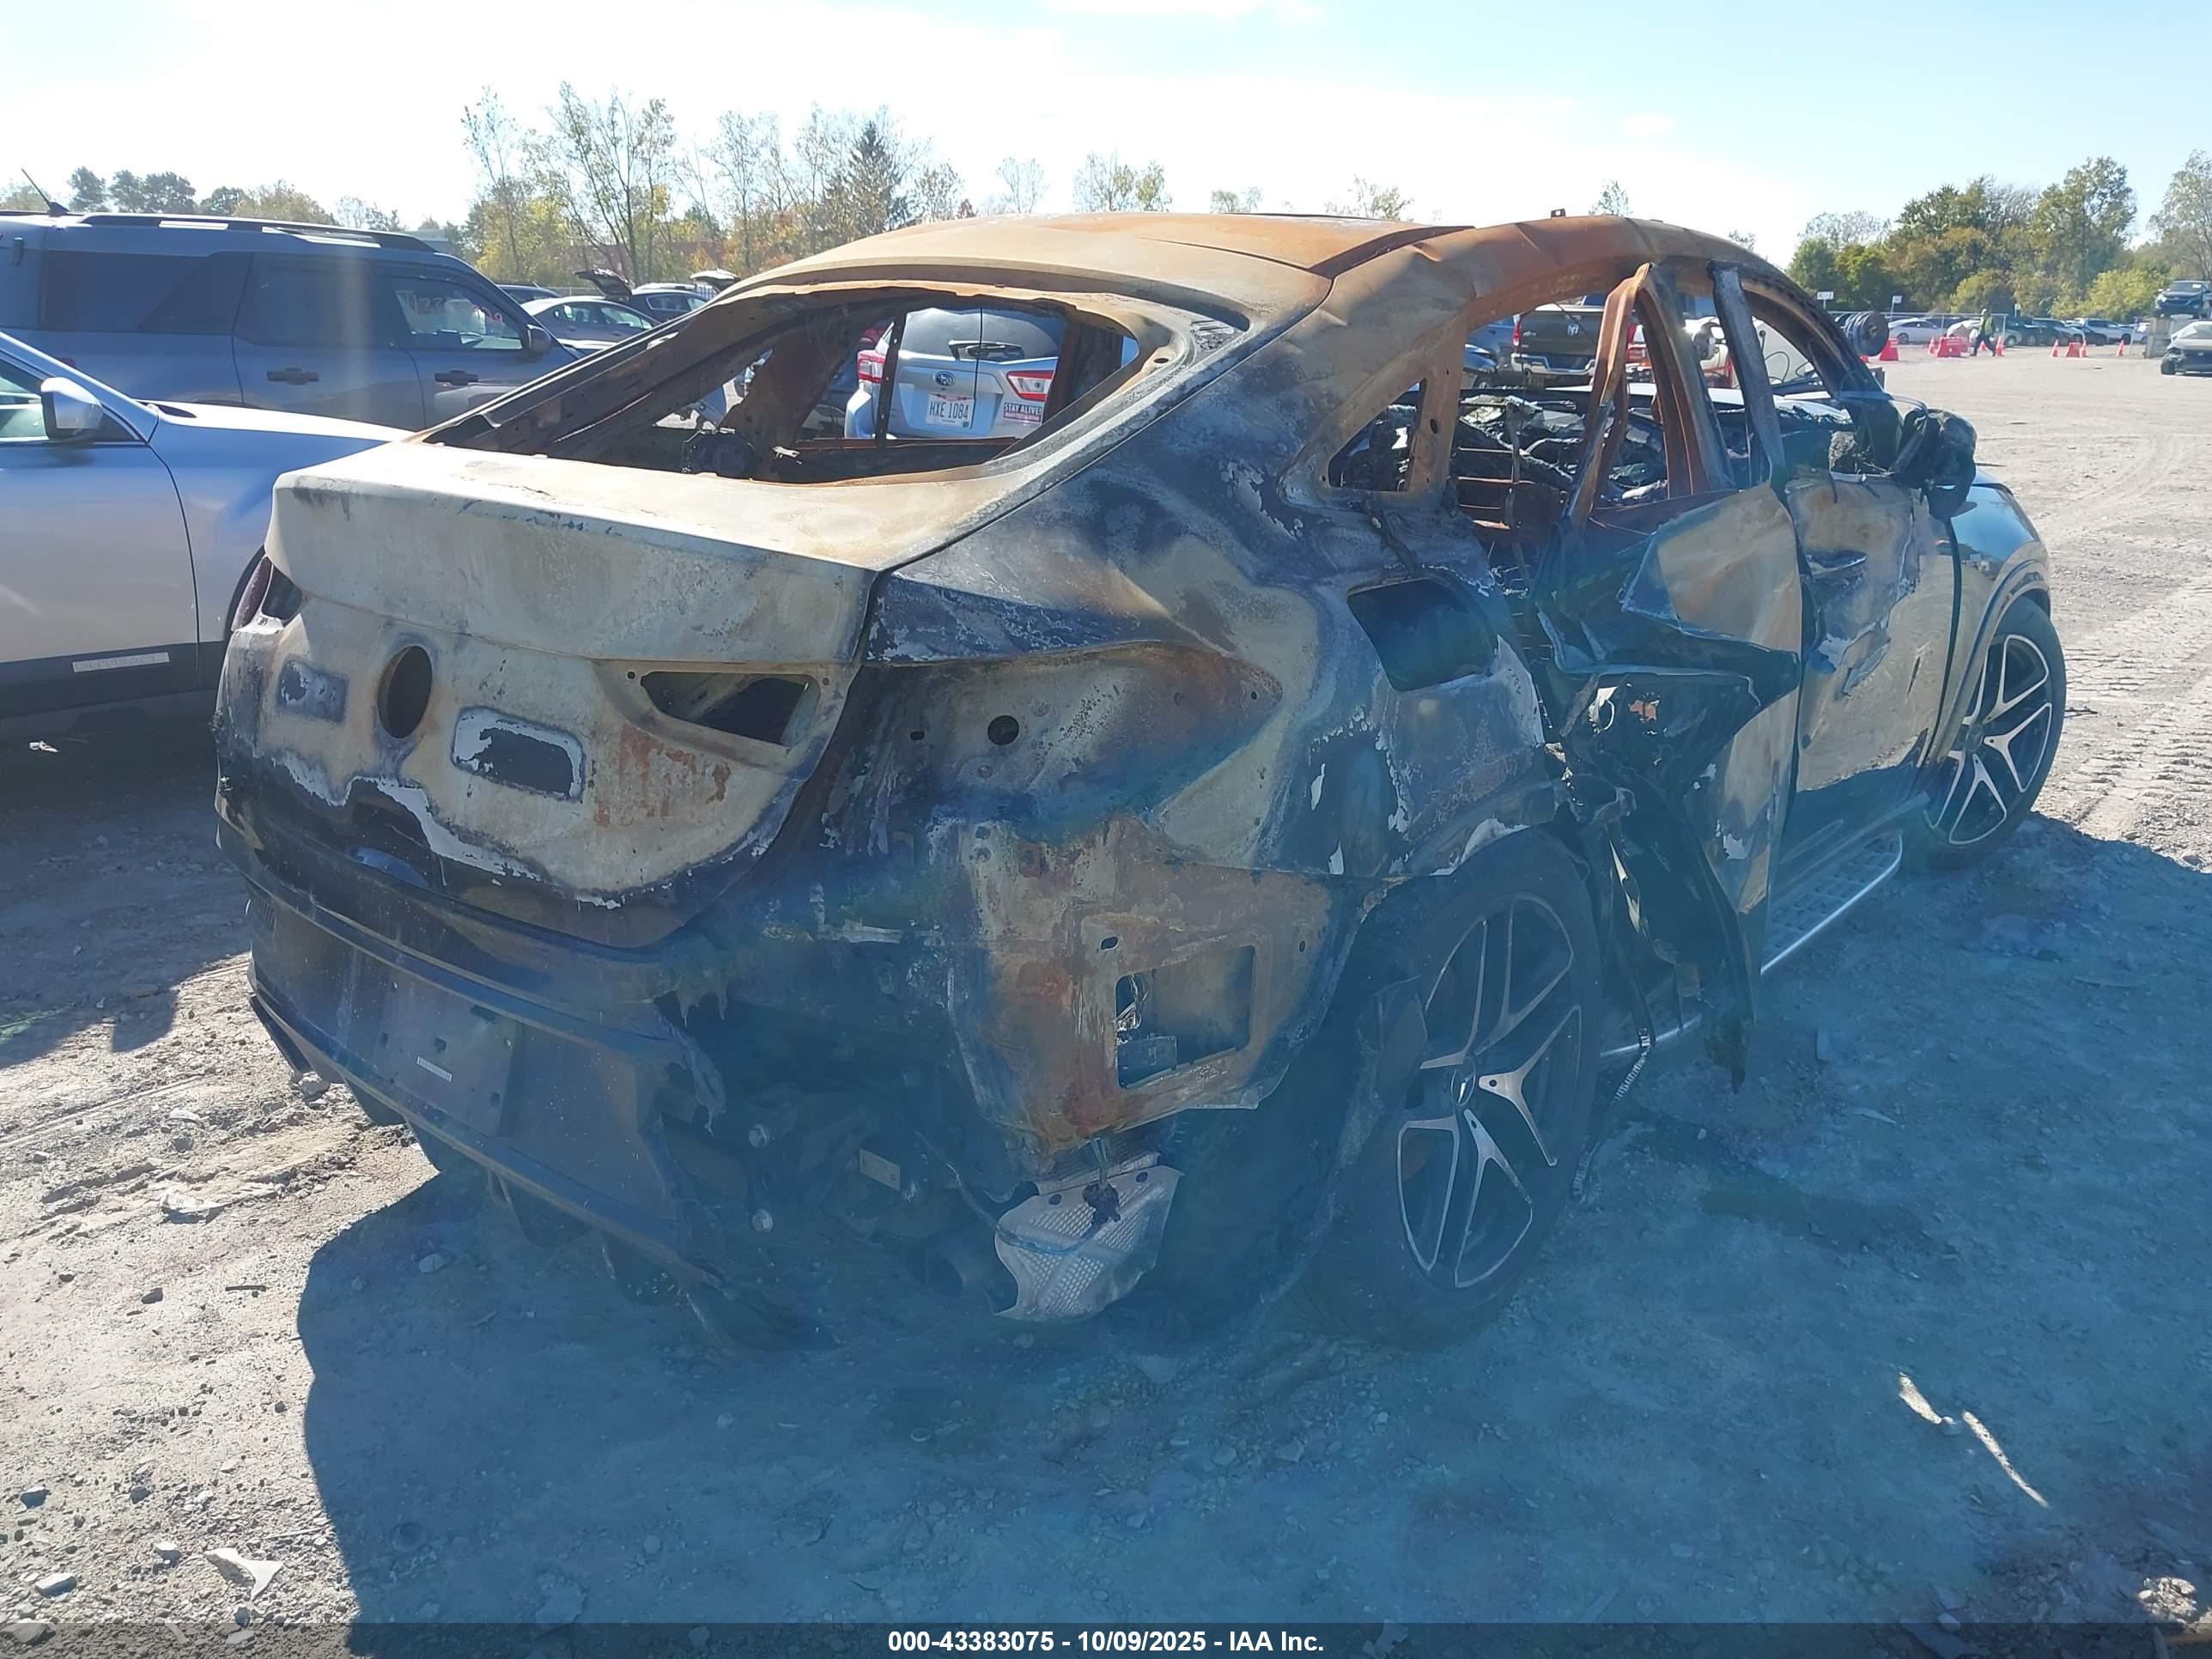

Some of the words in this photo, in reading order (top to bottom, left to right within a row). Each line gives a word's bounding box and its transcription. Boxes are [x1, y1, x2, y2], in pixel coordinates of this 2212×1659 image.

[929, 401, 946, 417] HXE
[948, 402, 969, 420] 1084
[1005, 403, 1020, 413] STAY
[1019, 404, 1042, 416] ALIVE!
